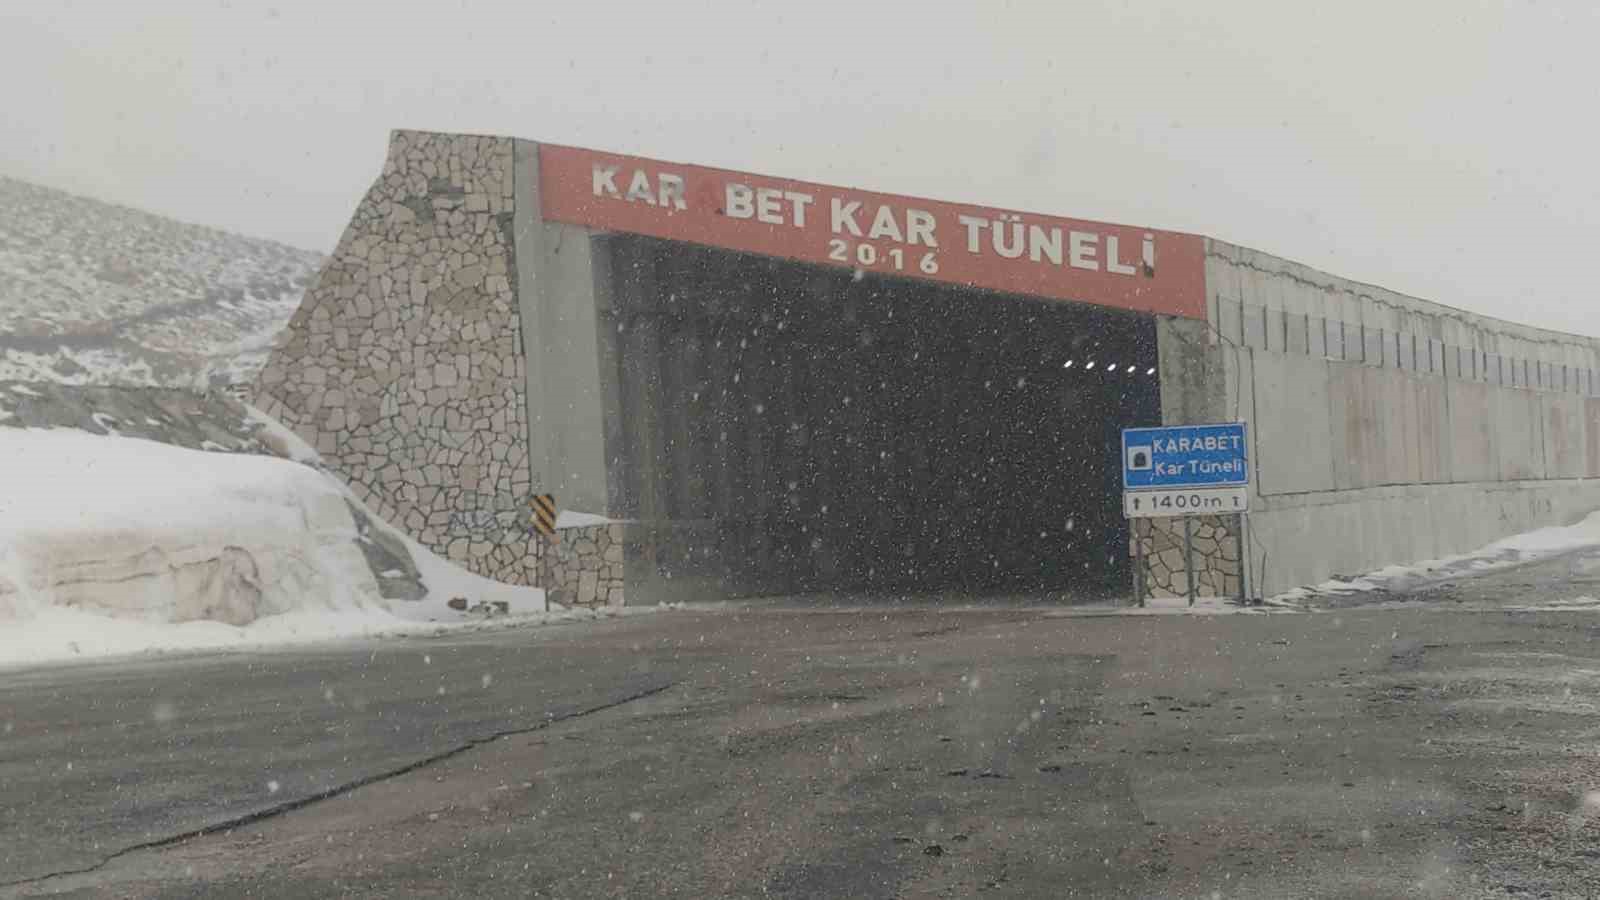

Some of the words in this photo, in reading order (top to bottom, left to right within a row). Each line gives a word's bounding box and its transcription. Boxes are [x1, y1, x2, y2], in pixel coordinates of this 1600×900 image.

[592, 164, 688, 210] KAR
[725, 183, 813, 228] BET
[831, 197, 939, 248] KAR
[829, 239, 939, 275] 2016
[1152, 435, 1241, 453] KARABET
[1154, 461, 1185, 477] Kar
[1187, 459, 1241, 474] Tüneli
[1152, 494, 1222, 510] 1400m
